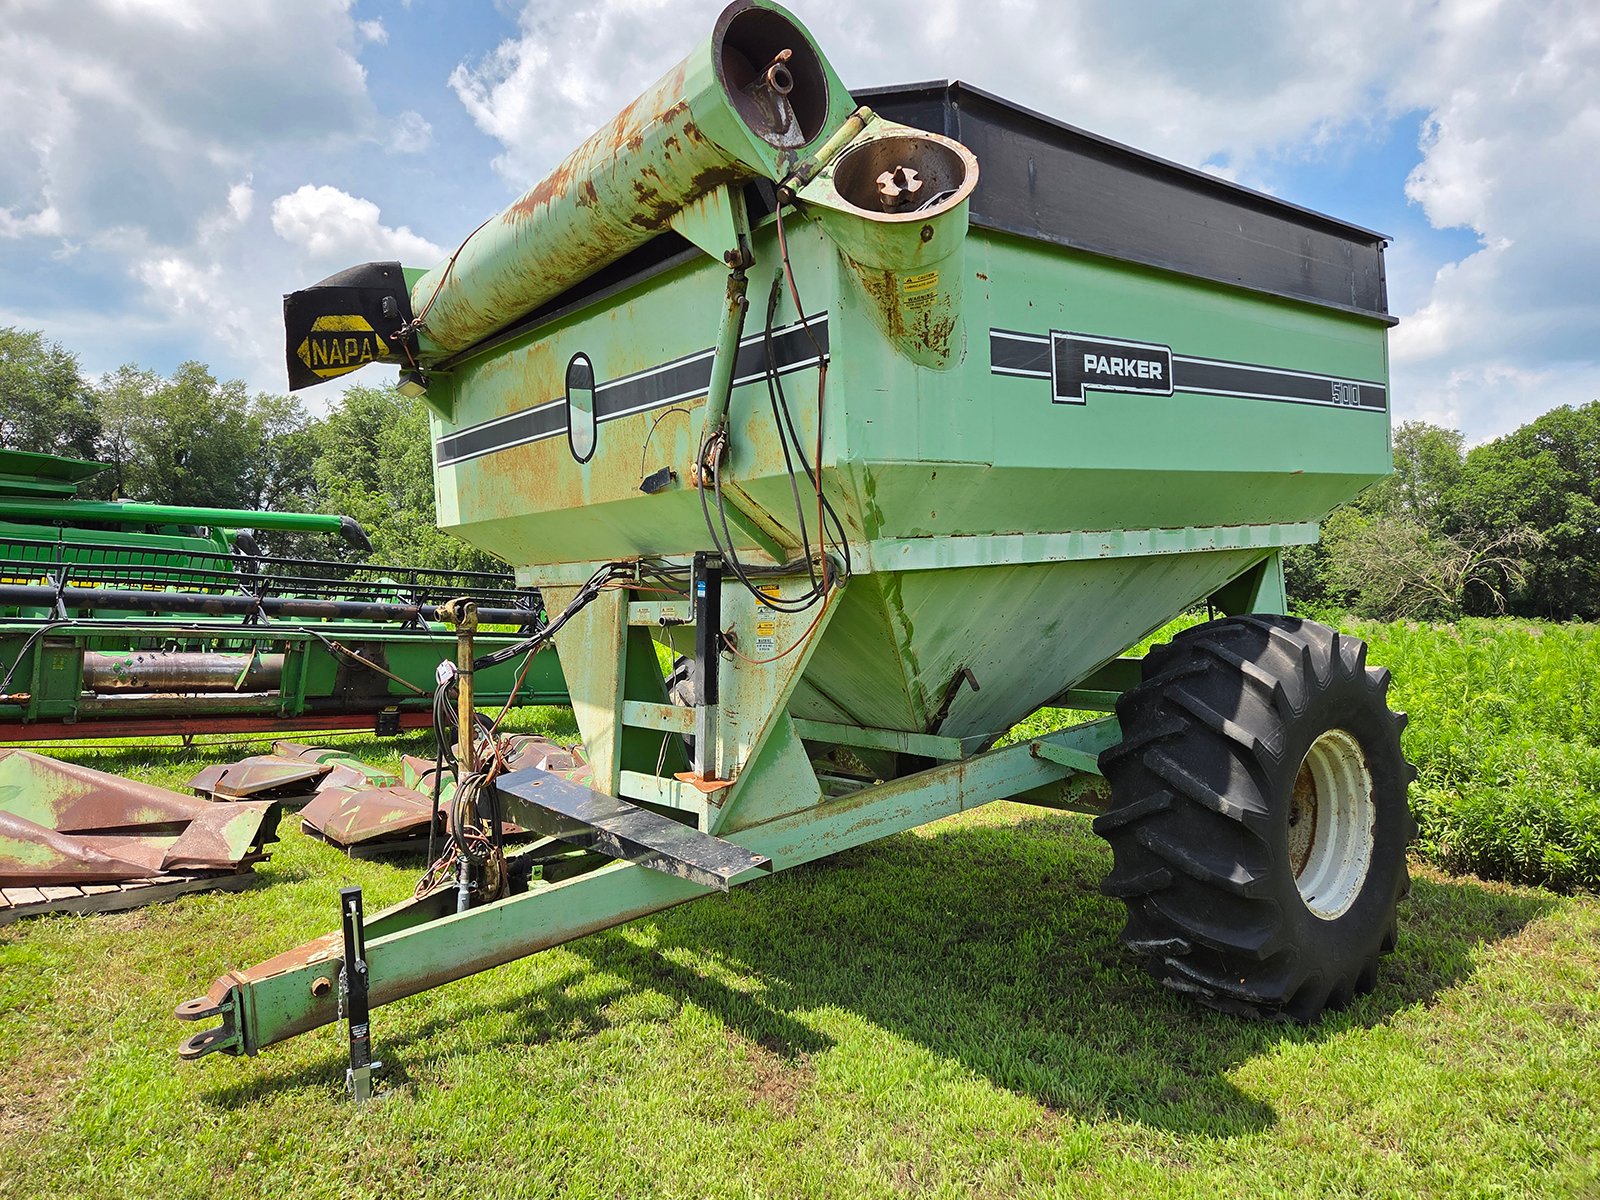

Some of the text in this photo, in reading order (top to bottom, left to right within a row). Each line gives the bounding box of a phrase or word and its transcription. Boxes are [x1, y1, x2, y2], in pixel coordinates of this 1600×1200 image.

[908, 292, 934, 302] WARNING
[312, 337, 373, 365] NAPA
[1084, 353, 1163, 380] PARKER
[1331, 378, 1360, 406] 500
